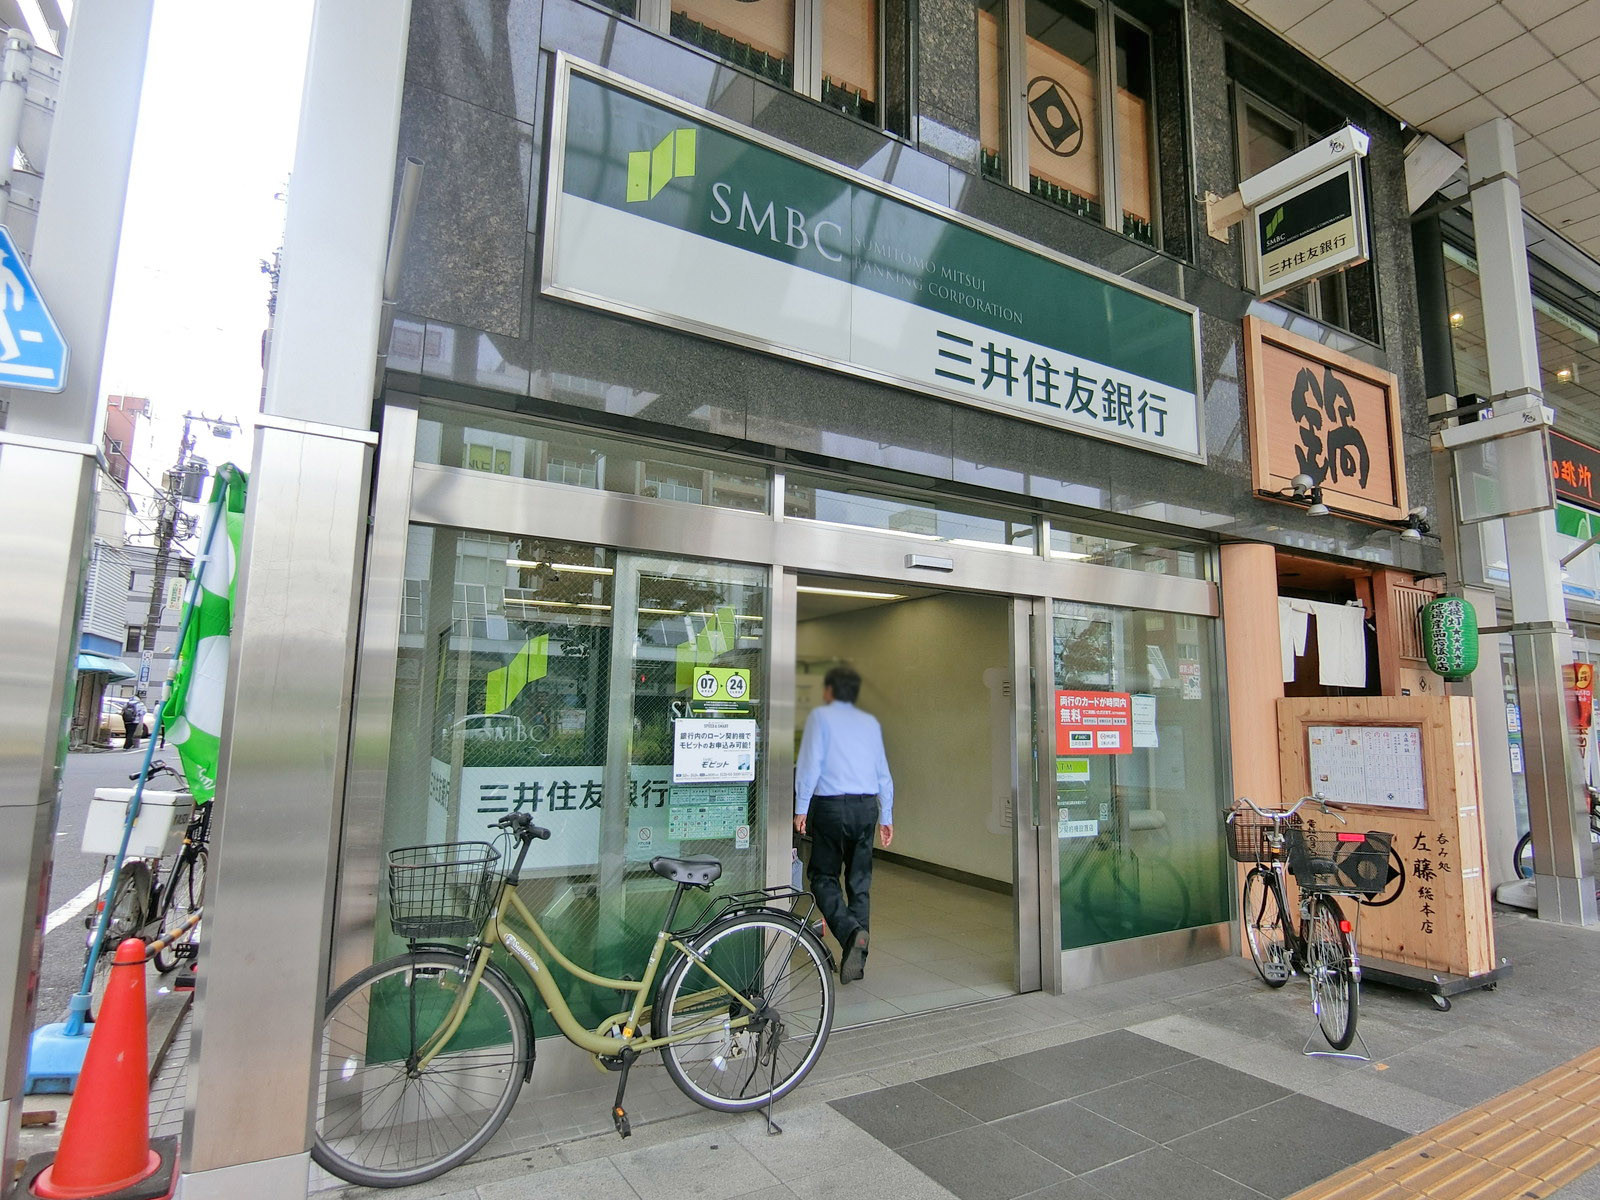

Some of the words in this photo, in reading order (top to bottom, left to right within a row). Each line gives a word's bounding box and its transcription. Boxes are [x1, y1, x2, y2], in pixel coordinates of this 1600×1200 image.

[709, 182, 843, 262] SMBC
[1266, 233, 1286, 247] SMBC
[1268, 233, 1347, 277] 三井住友銀行
[854, 234, 936, 274] SUMITOMO
[941, 265, 986, 293] MITSUI
[854, 256, 924, 292] BANKING
[927, 282, 1024, 325] CORPORATION
[934, 329, 1168, 437] 三井住友銀行
[700, 677, 715, 690] 07
[730, 678, 743, 691] 24
[1059, 695, 1127, 708] 両行のカードが時間内
[1060, 708, 1081, 723] 無料
[482, 724, 546, 743] SMBC
[680, 731, 752, 741] 銀行内のローン契約機で
[701, 760, 730, 769] モビット
[1436, 832, 1452, 873] 呑み処
[1411, 830, 1438, 934] 左藤総本店
